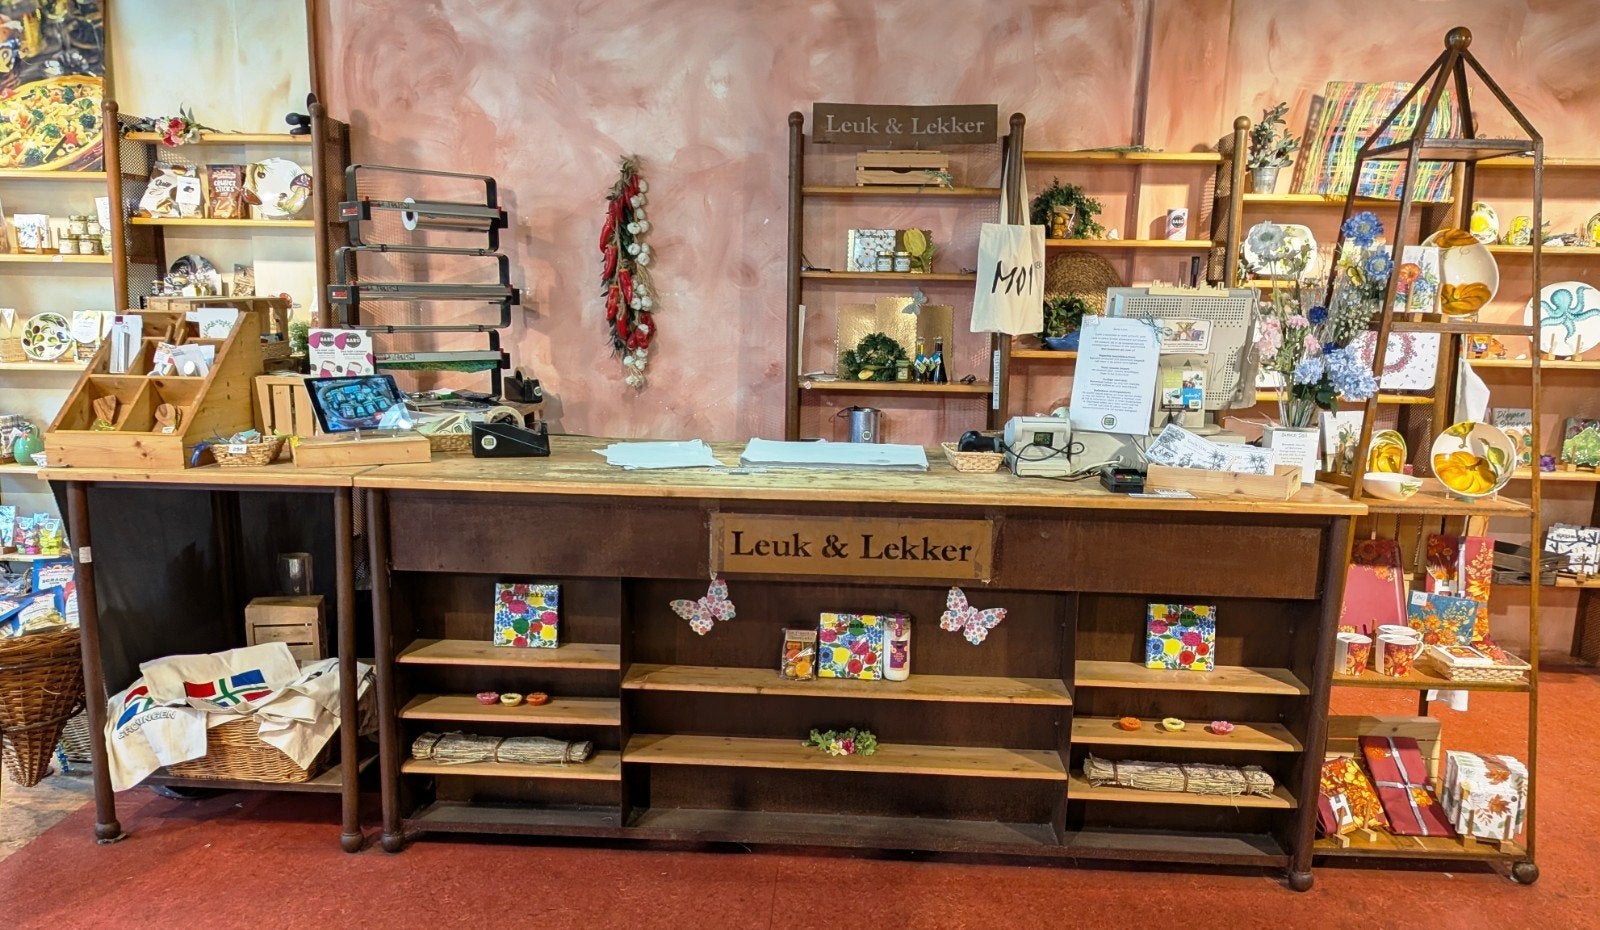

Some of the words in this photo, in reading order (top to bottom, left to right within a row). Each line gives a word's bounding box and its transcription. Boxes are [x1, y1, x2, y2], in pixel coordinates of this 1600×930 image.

[825, 114, 879, 134] Leuk
[885, 117, 903, 134] &
[911, 115, 984, 135] Lekker
[992, 260, 1032, 296] MOI
[730, 530, 812, 558] Leuk
[821, 534, 849, 558] &
[859, 534, 972, 562] Lekker
